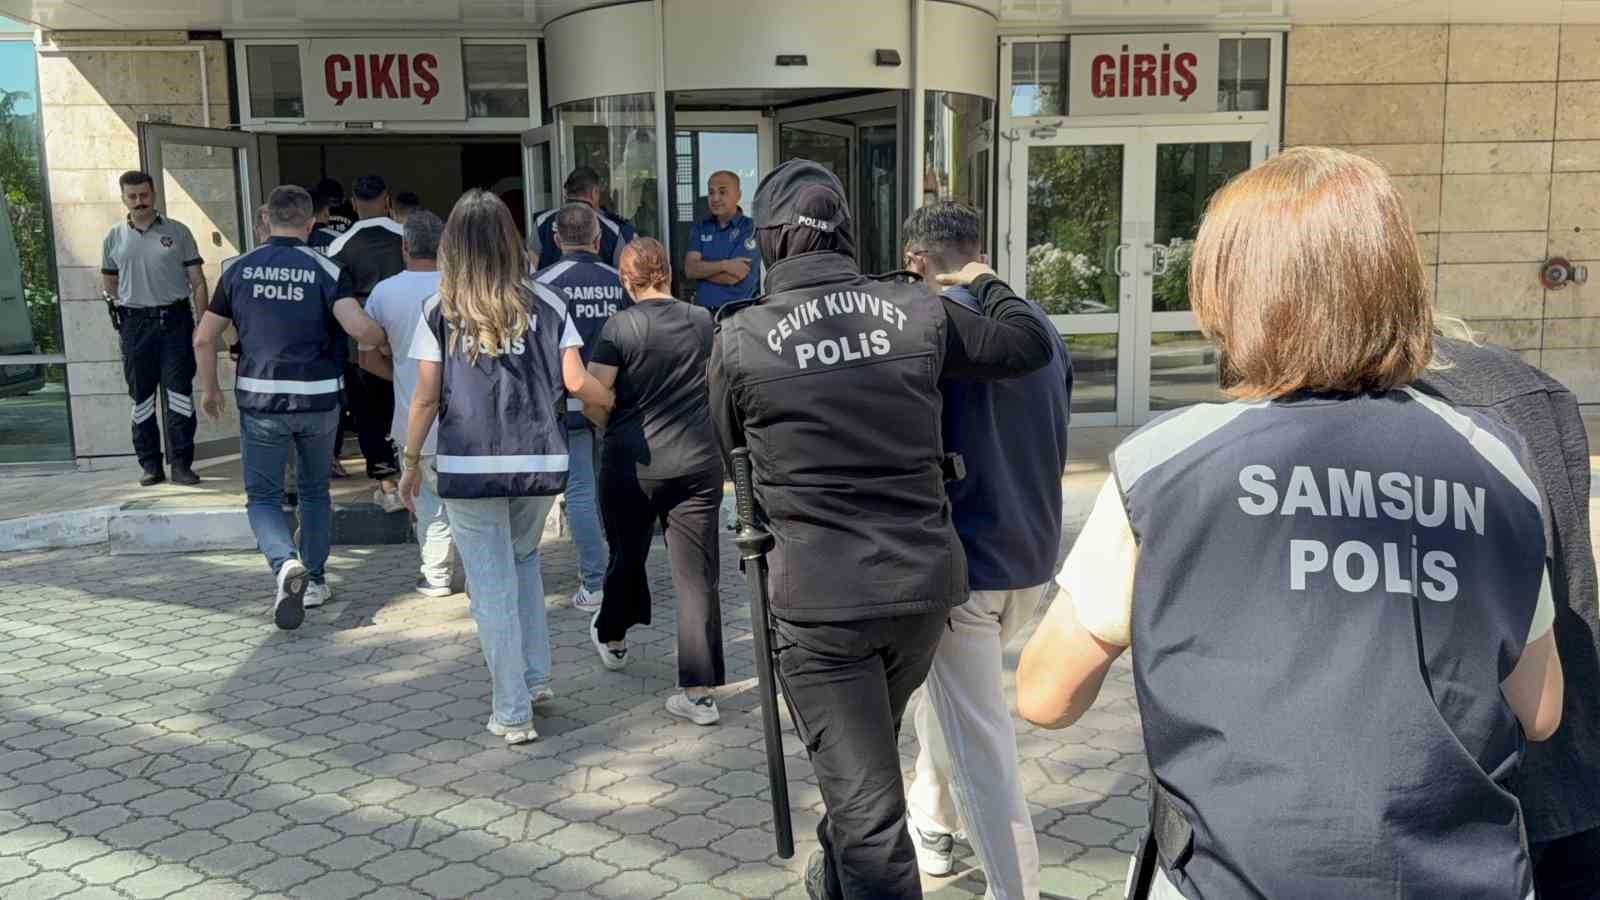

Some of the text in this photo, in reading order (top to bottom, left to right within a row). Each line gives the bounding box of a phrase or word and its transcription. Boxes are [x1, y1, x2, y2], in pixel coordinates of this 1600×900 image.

[324, 53, 440, 106] ÇIKIŞ
[1091, 43, 1198, 102] GİRİŞ
[242, 266, 316, 284] SAMSUN
[253, 283, 304, 301] POLİS
[824, 291, 908, 331] KUVVET
[1238, 464, 1486, 536] SAMSUN
[1290, 534, 1458, 602] POLİS
